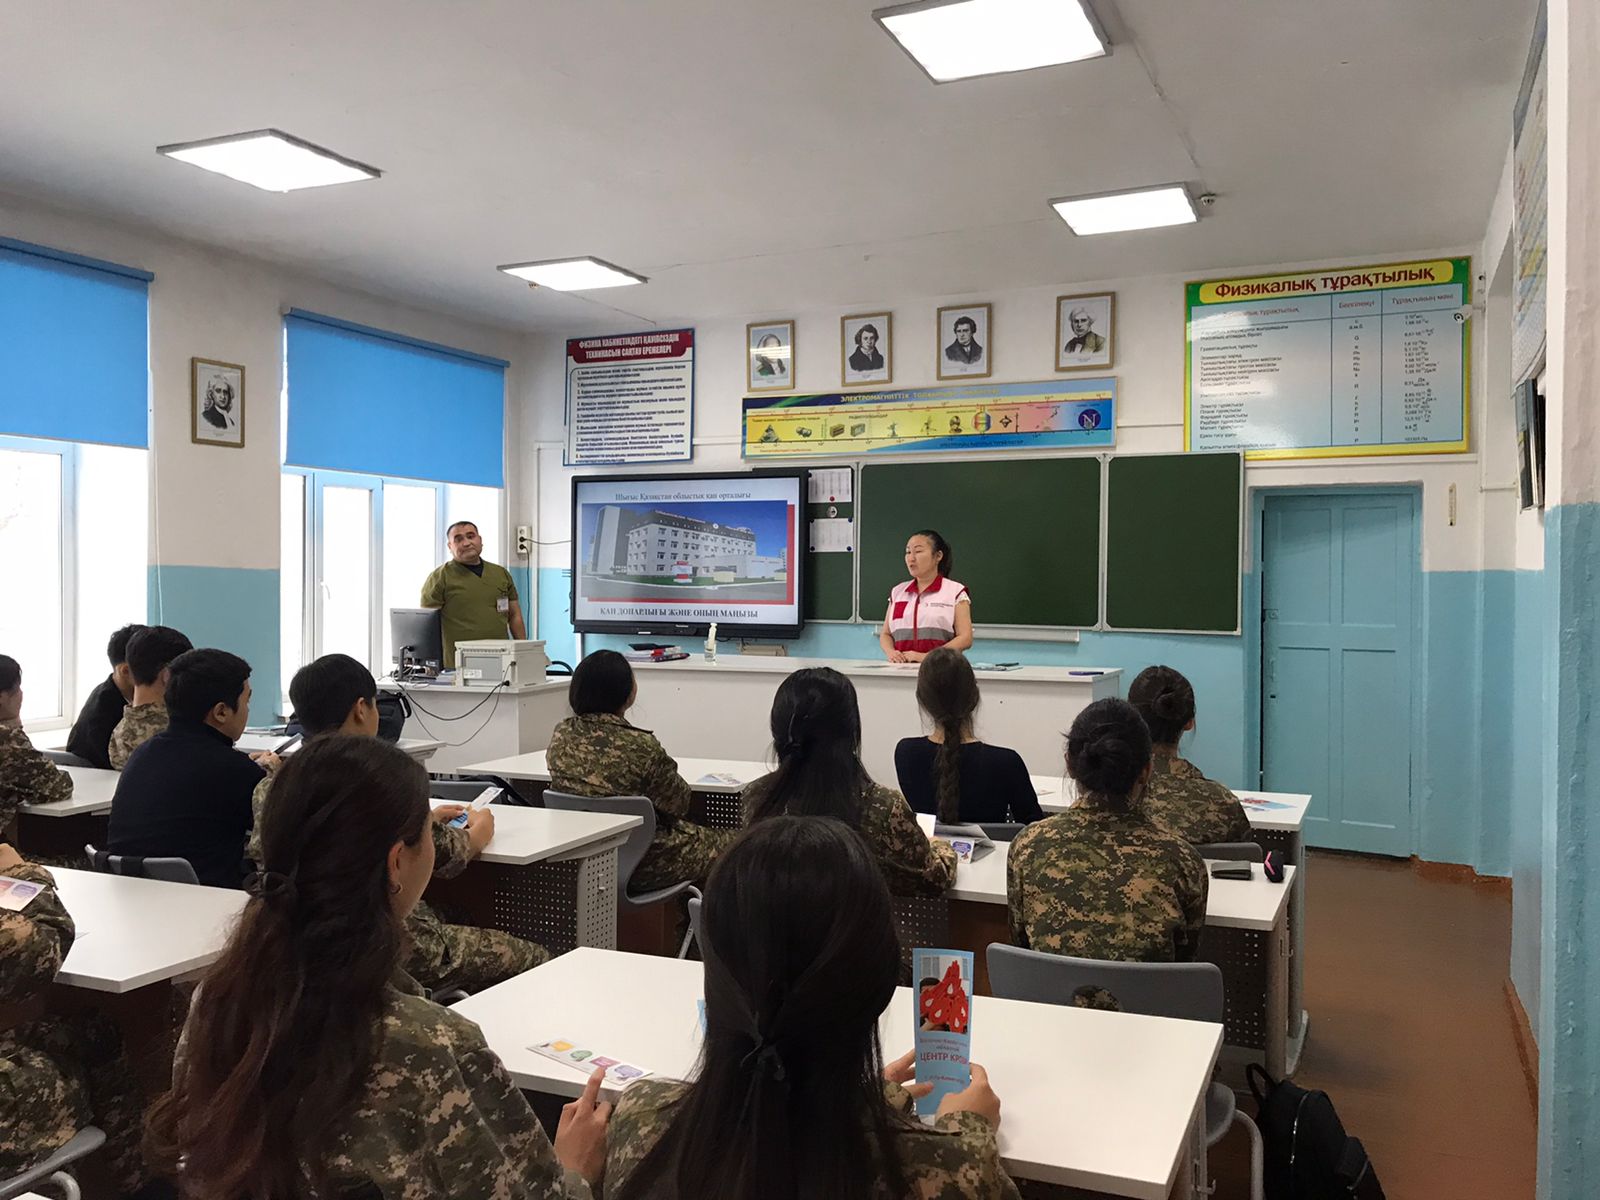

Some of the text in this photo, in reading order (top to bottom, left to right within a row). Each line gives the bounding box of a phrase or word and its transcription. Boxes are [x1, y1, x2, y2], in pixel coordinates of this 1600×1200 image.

[1215, 265, 1435, 298] Физикалық тұрақтылық
[639, 493, 671, 502] Қазақстан
[667, 608, 693, 617] ЖӘНЕ
[693, 608, 719, 618] ОНЫҢ
[920, 1052, 949, 1063] ЦЕНТР
